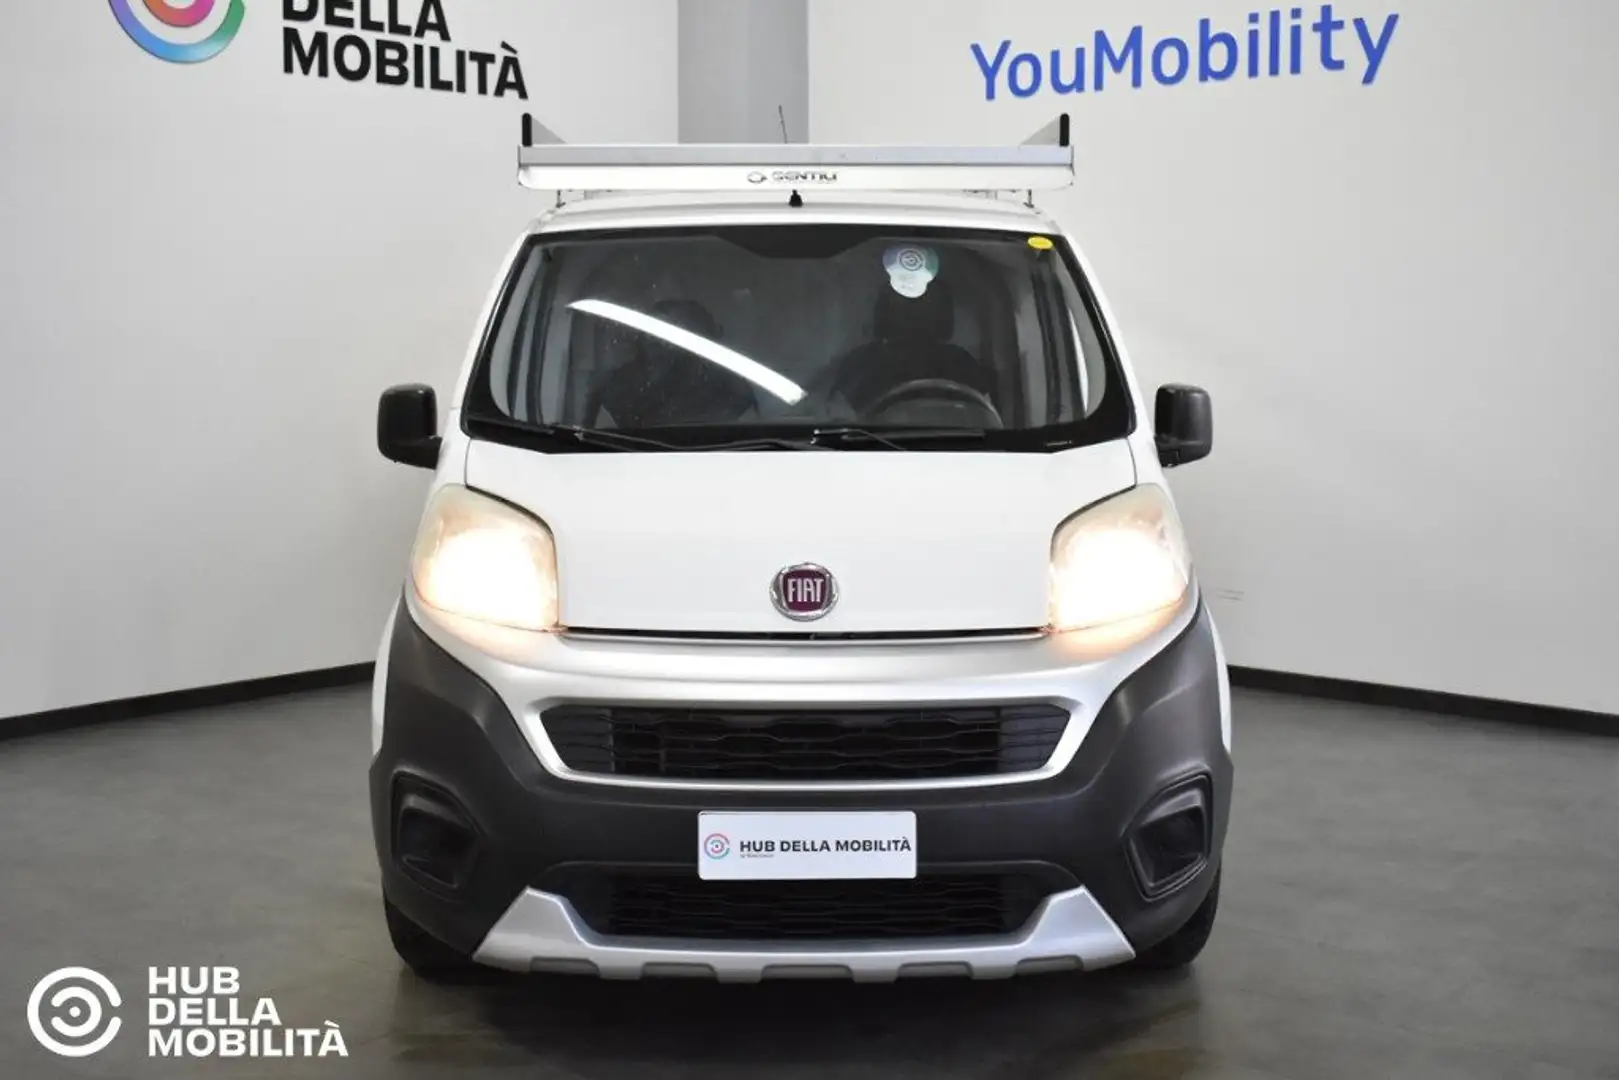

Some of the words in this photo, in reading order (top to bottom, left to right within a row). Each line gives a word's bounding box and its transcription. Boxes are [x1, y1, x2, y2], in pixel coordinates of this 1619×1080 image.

[283, 26, 529, 100] MOBILITÀ
[970, 4, 1399, 101] YouMobility
[787, 578, 824, 603] FIAT
[740, 840, 776, 852] HUB
[780, 840, 831, 852] DELLA
[835, 837, 912, 852] MOBILITÀ
